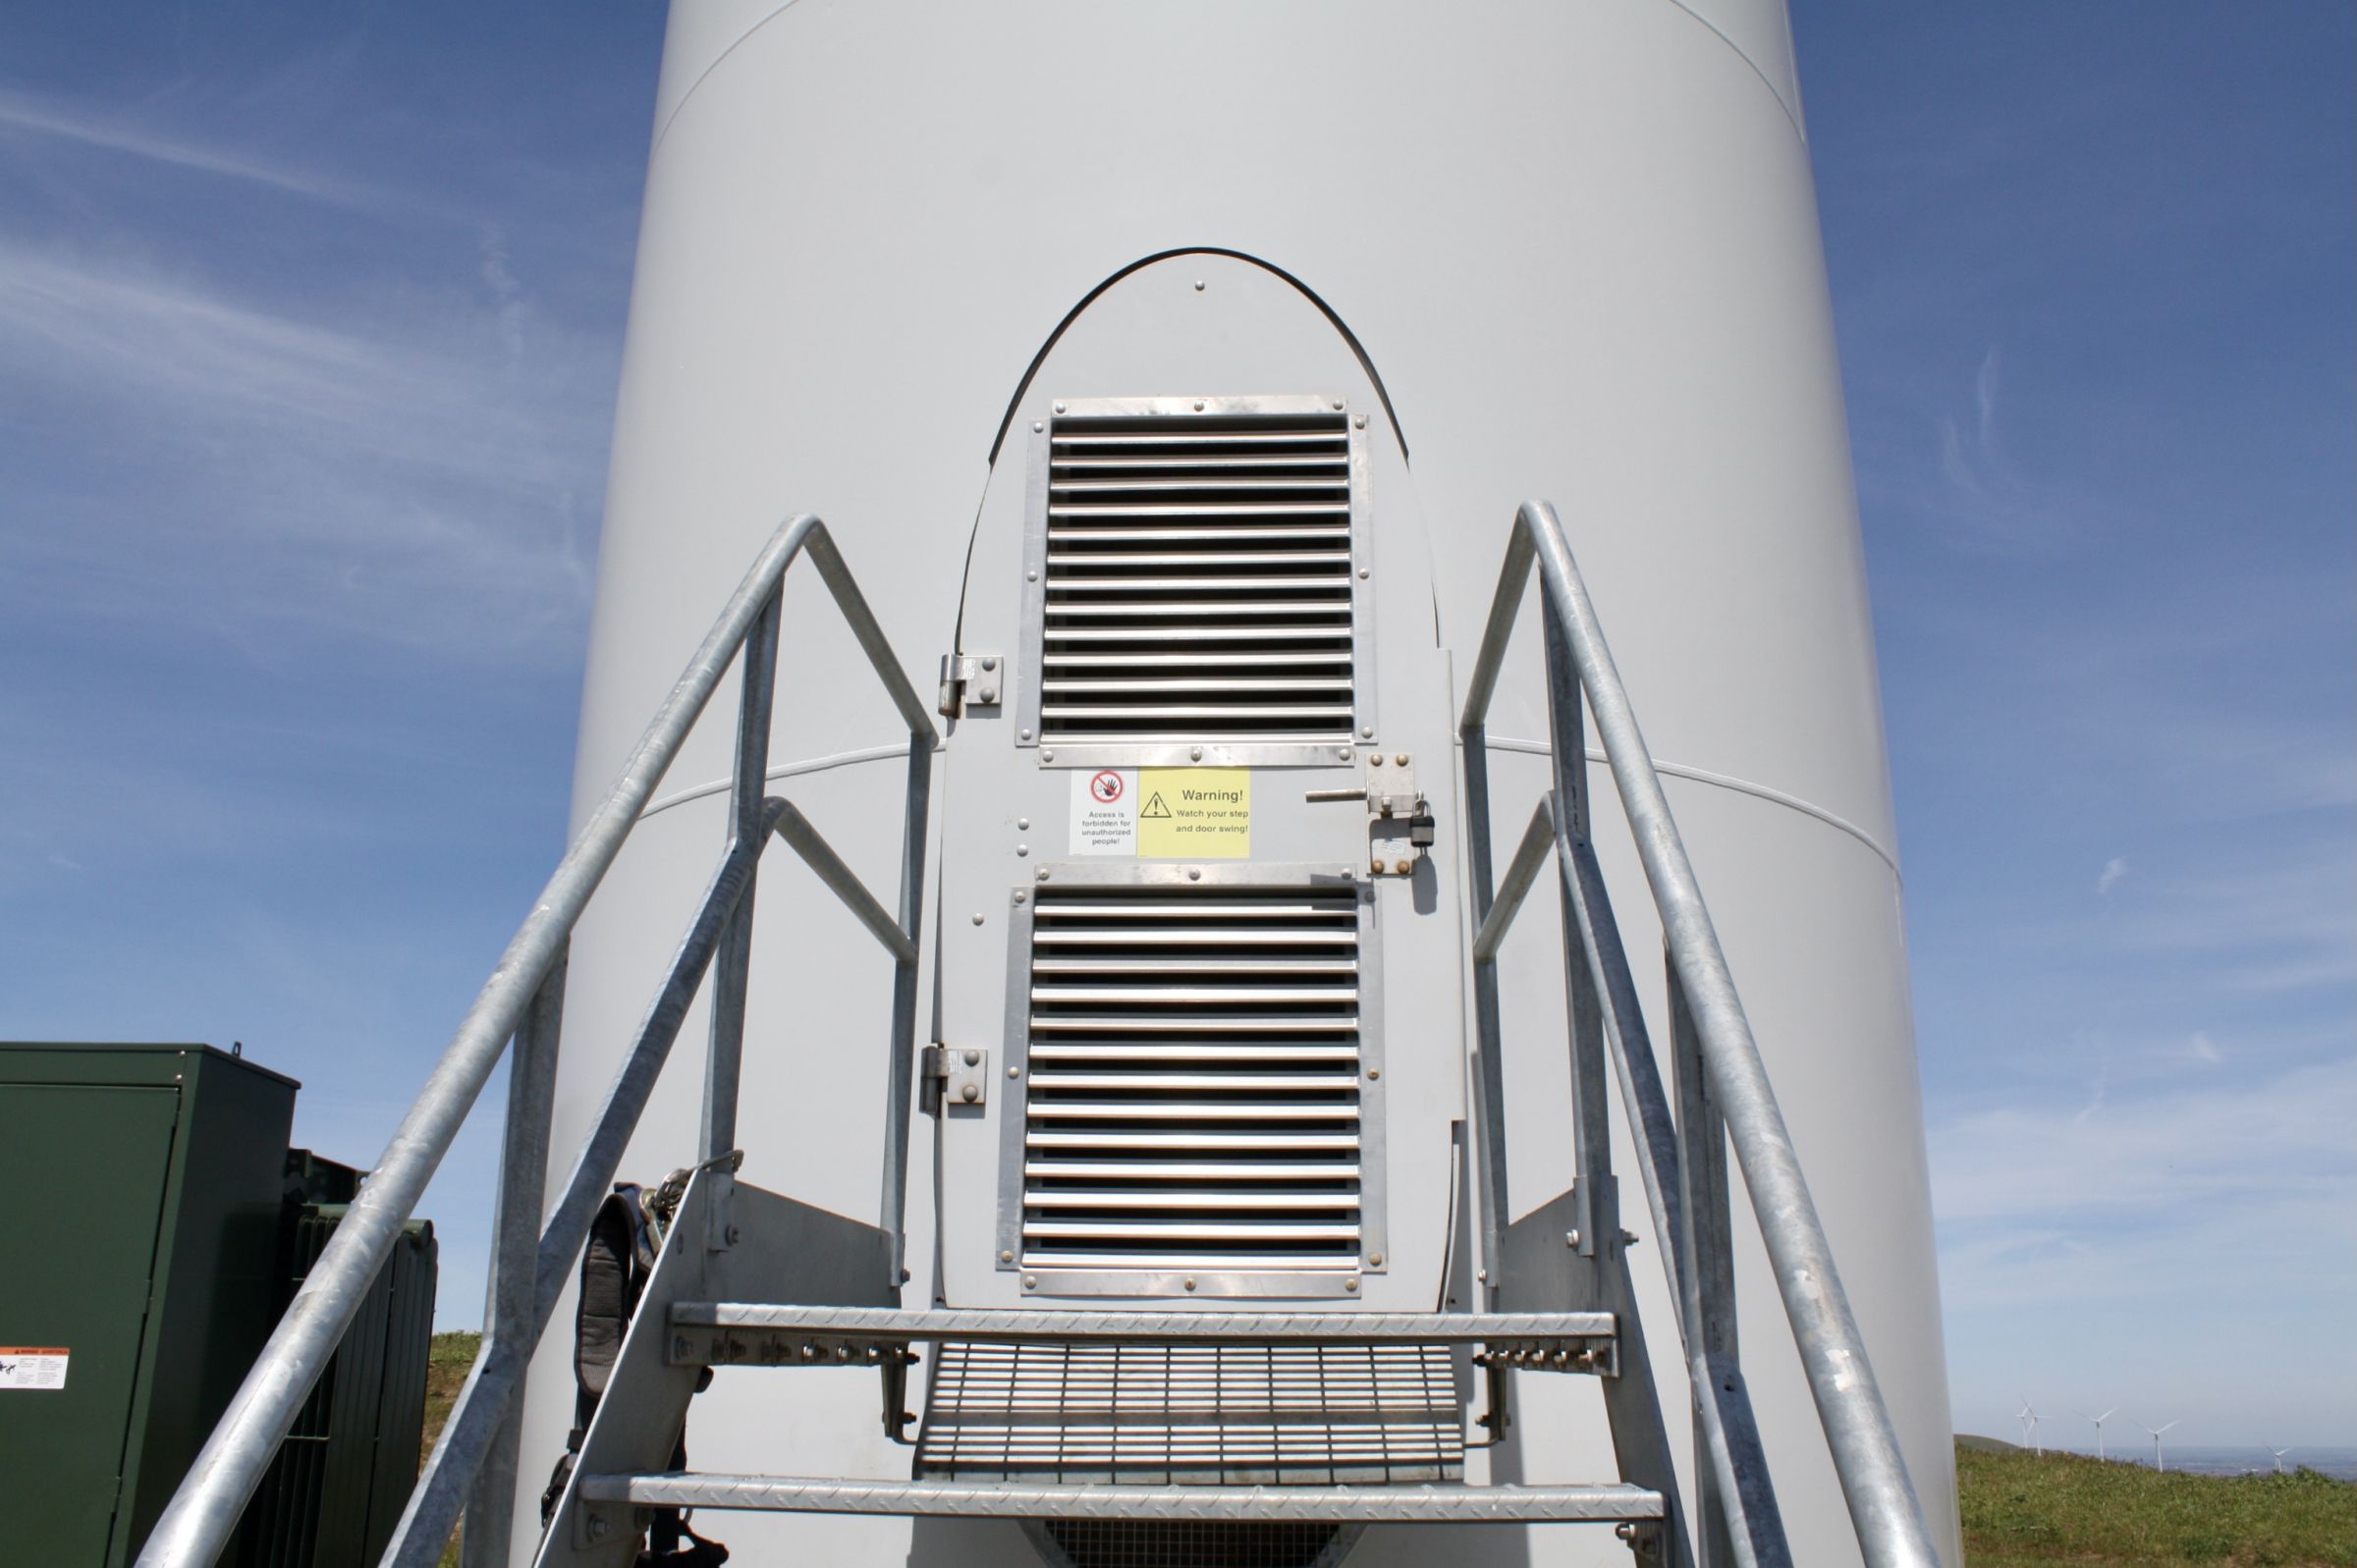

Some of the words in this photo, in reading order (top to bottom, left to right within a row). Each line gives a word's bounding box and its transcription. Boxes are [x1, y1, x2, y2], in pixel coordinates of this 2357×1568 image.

[1181, 788, 1243, 804] Warning!
[1176, 809, 1204, 817] Watch
[1206, 810, 1227, 819] your
[1229, 809, 1249, 819] step
[1218, 824, 1248, 834] swing!
[1092, 838, 1120, 846] people!
